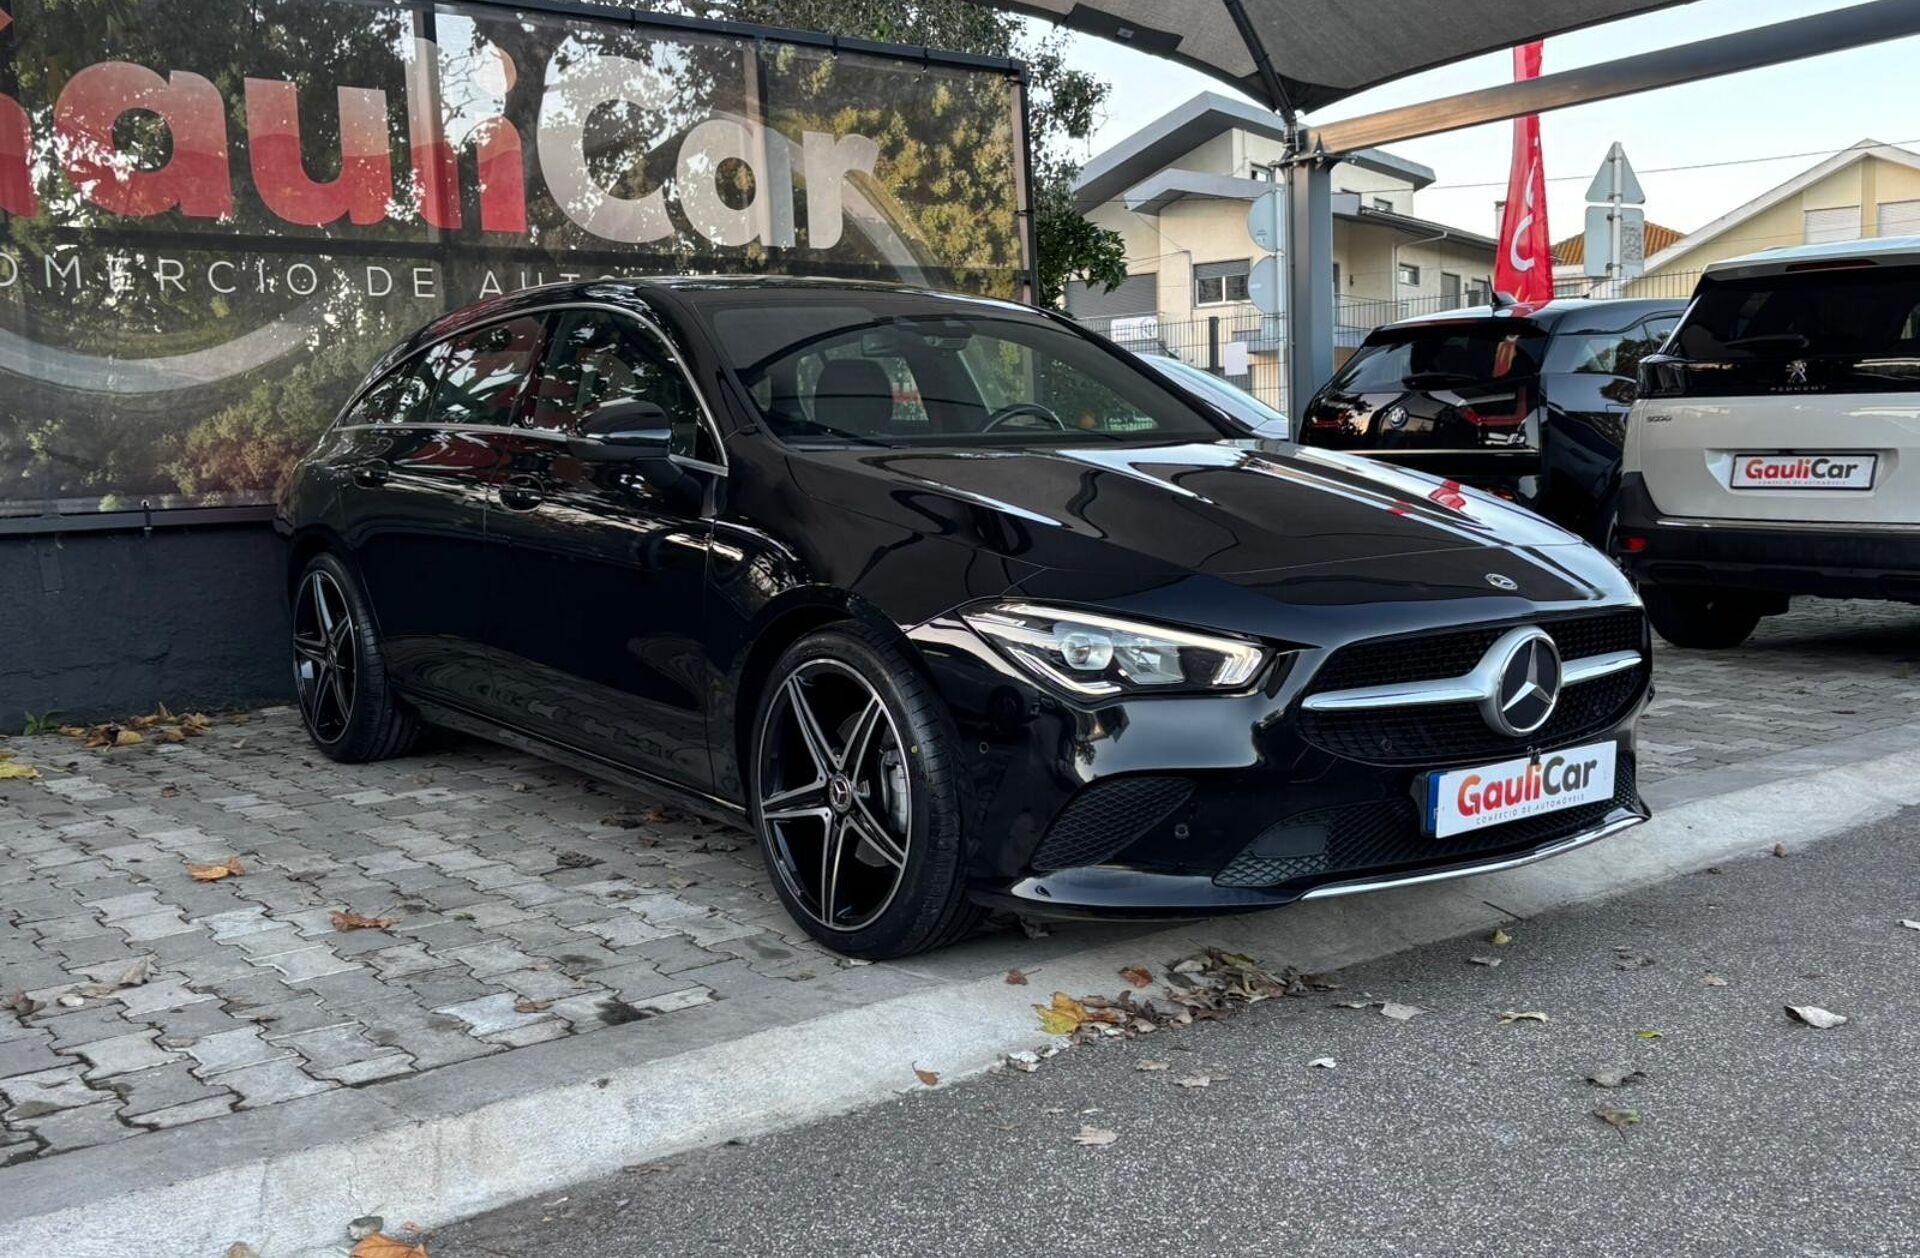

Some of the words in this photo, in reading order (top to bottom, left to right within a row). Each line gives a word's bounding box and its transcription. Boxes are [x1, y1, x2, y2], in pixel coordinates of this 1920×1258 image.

[0, 8, 880, 251] auliCar
[366, 266, 435, 298] DE
[1745, 458, 1859, 479] GauliCar
[1457, 755, 1598, 817] GauliCar
